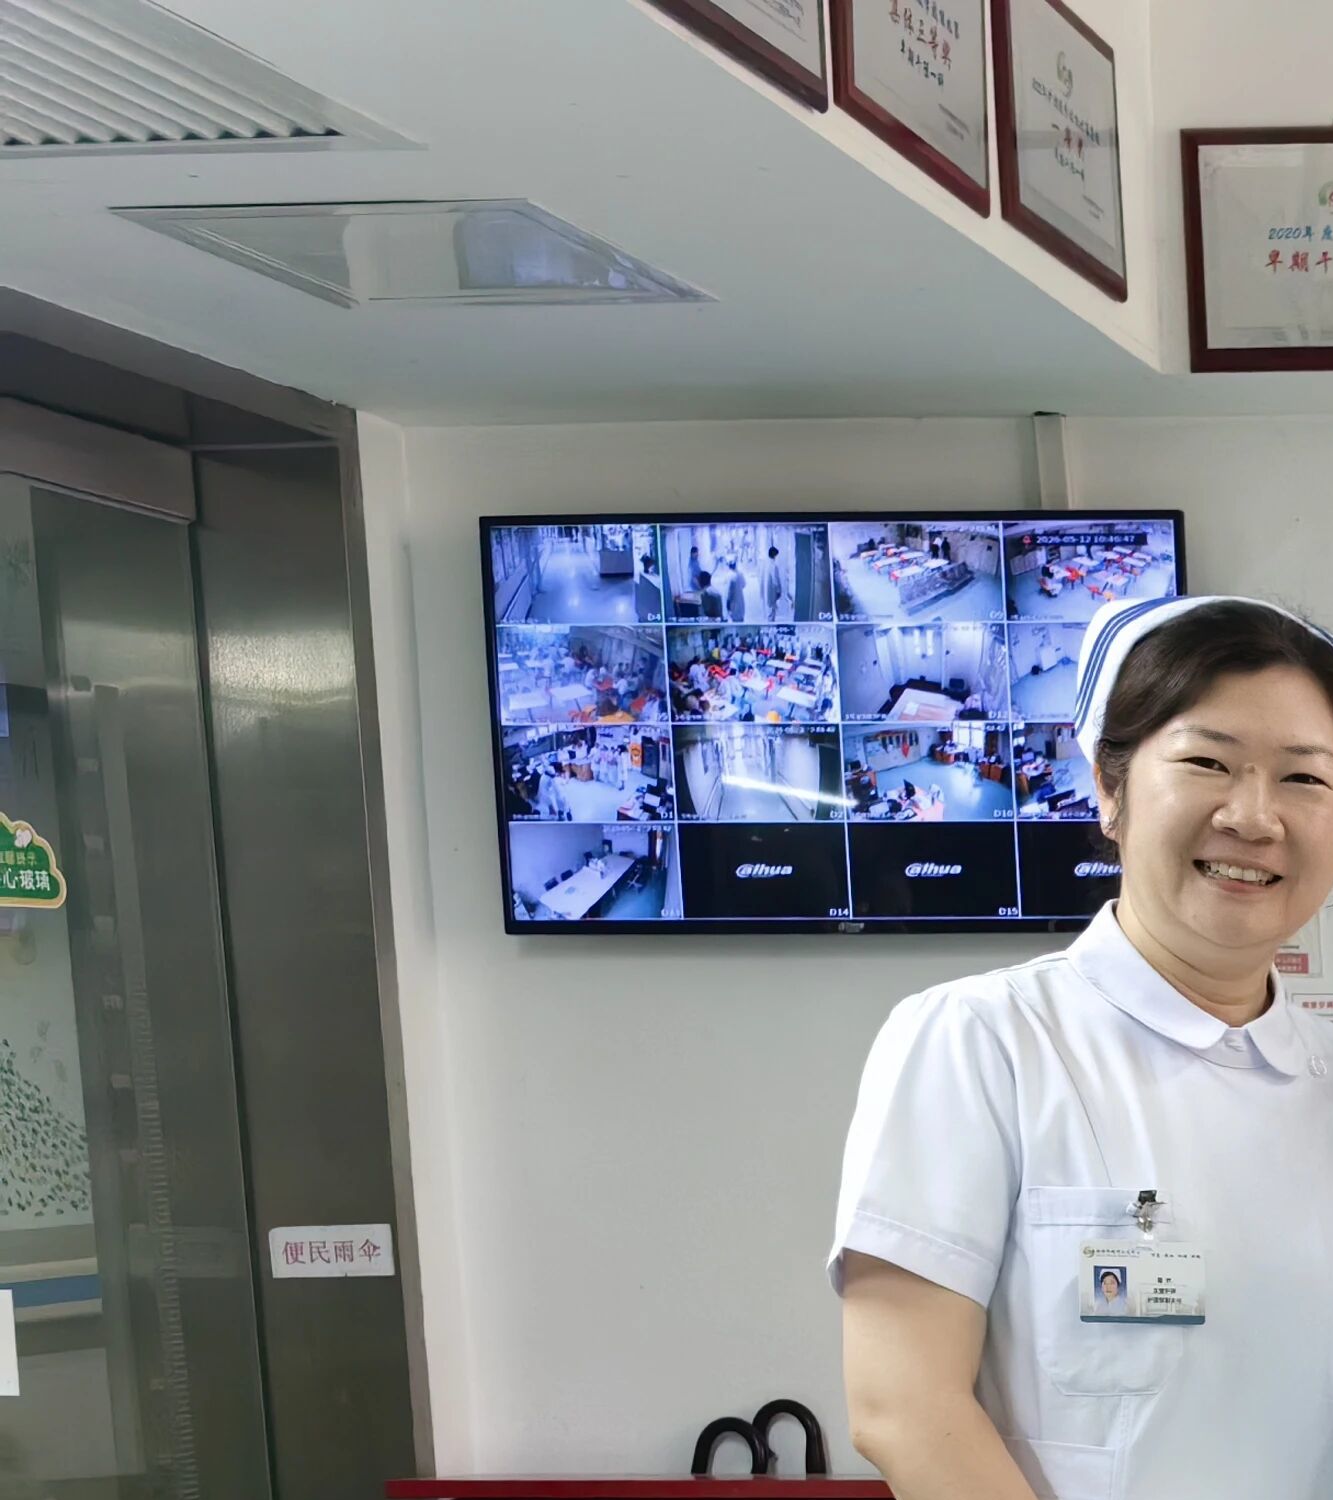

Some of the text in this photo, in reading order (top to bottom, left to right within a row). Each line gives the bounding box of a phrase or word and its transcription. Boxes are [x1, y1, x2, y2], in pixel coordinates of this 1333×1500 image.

[829, 908, 849, 916] D14
[282, 1239, 381, 1265] 便民雨伞
